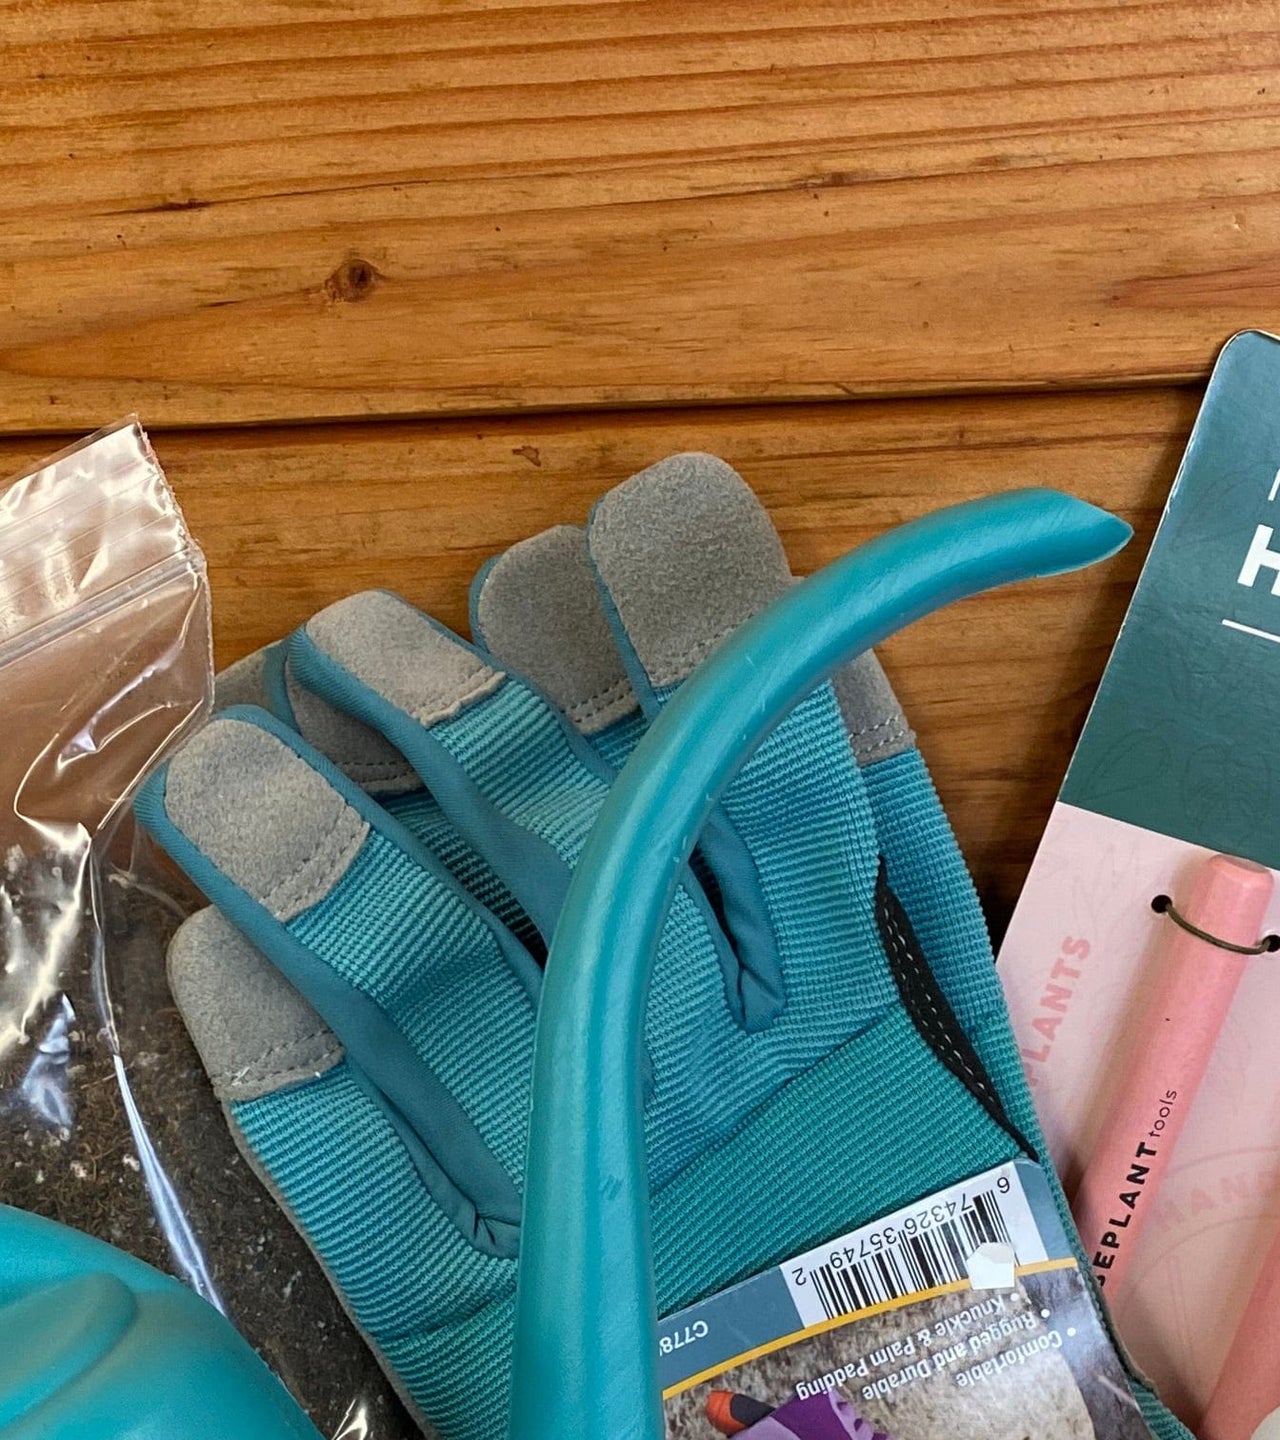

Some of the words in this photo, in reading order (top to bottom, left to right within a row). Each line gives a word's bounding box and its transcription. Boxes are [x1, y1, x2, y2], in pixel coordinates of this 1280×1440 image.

[1148, 1090, 1177, 1137] tools
[997, 1177, 1010, 1194] 6
[904, 1193, 973, 1235] 74326
[830, 1227, 897, 1269] 35749
[792, 1267, 807, 1286] 2
[937, 1294, 1006, 1336] Knuckle
[974, 1311, 1037, 1350] Rugged
[658, 1320, 708, 1357] C778
[871, 1339, 915, 1367] Palm
[918, 1330, 932, 1347] &
[934, 1335, 971, 1364] and
[956, 1329, 1063, 1388] Comfortable
[796, 1360, 869, 1401] Padding
[862, 1360, 932, 1401] Durable
